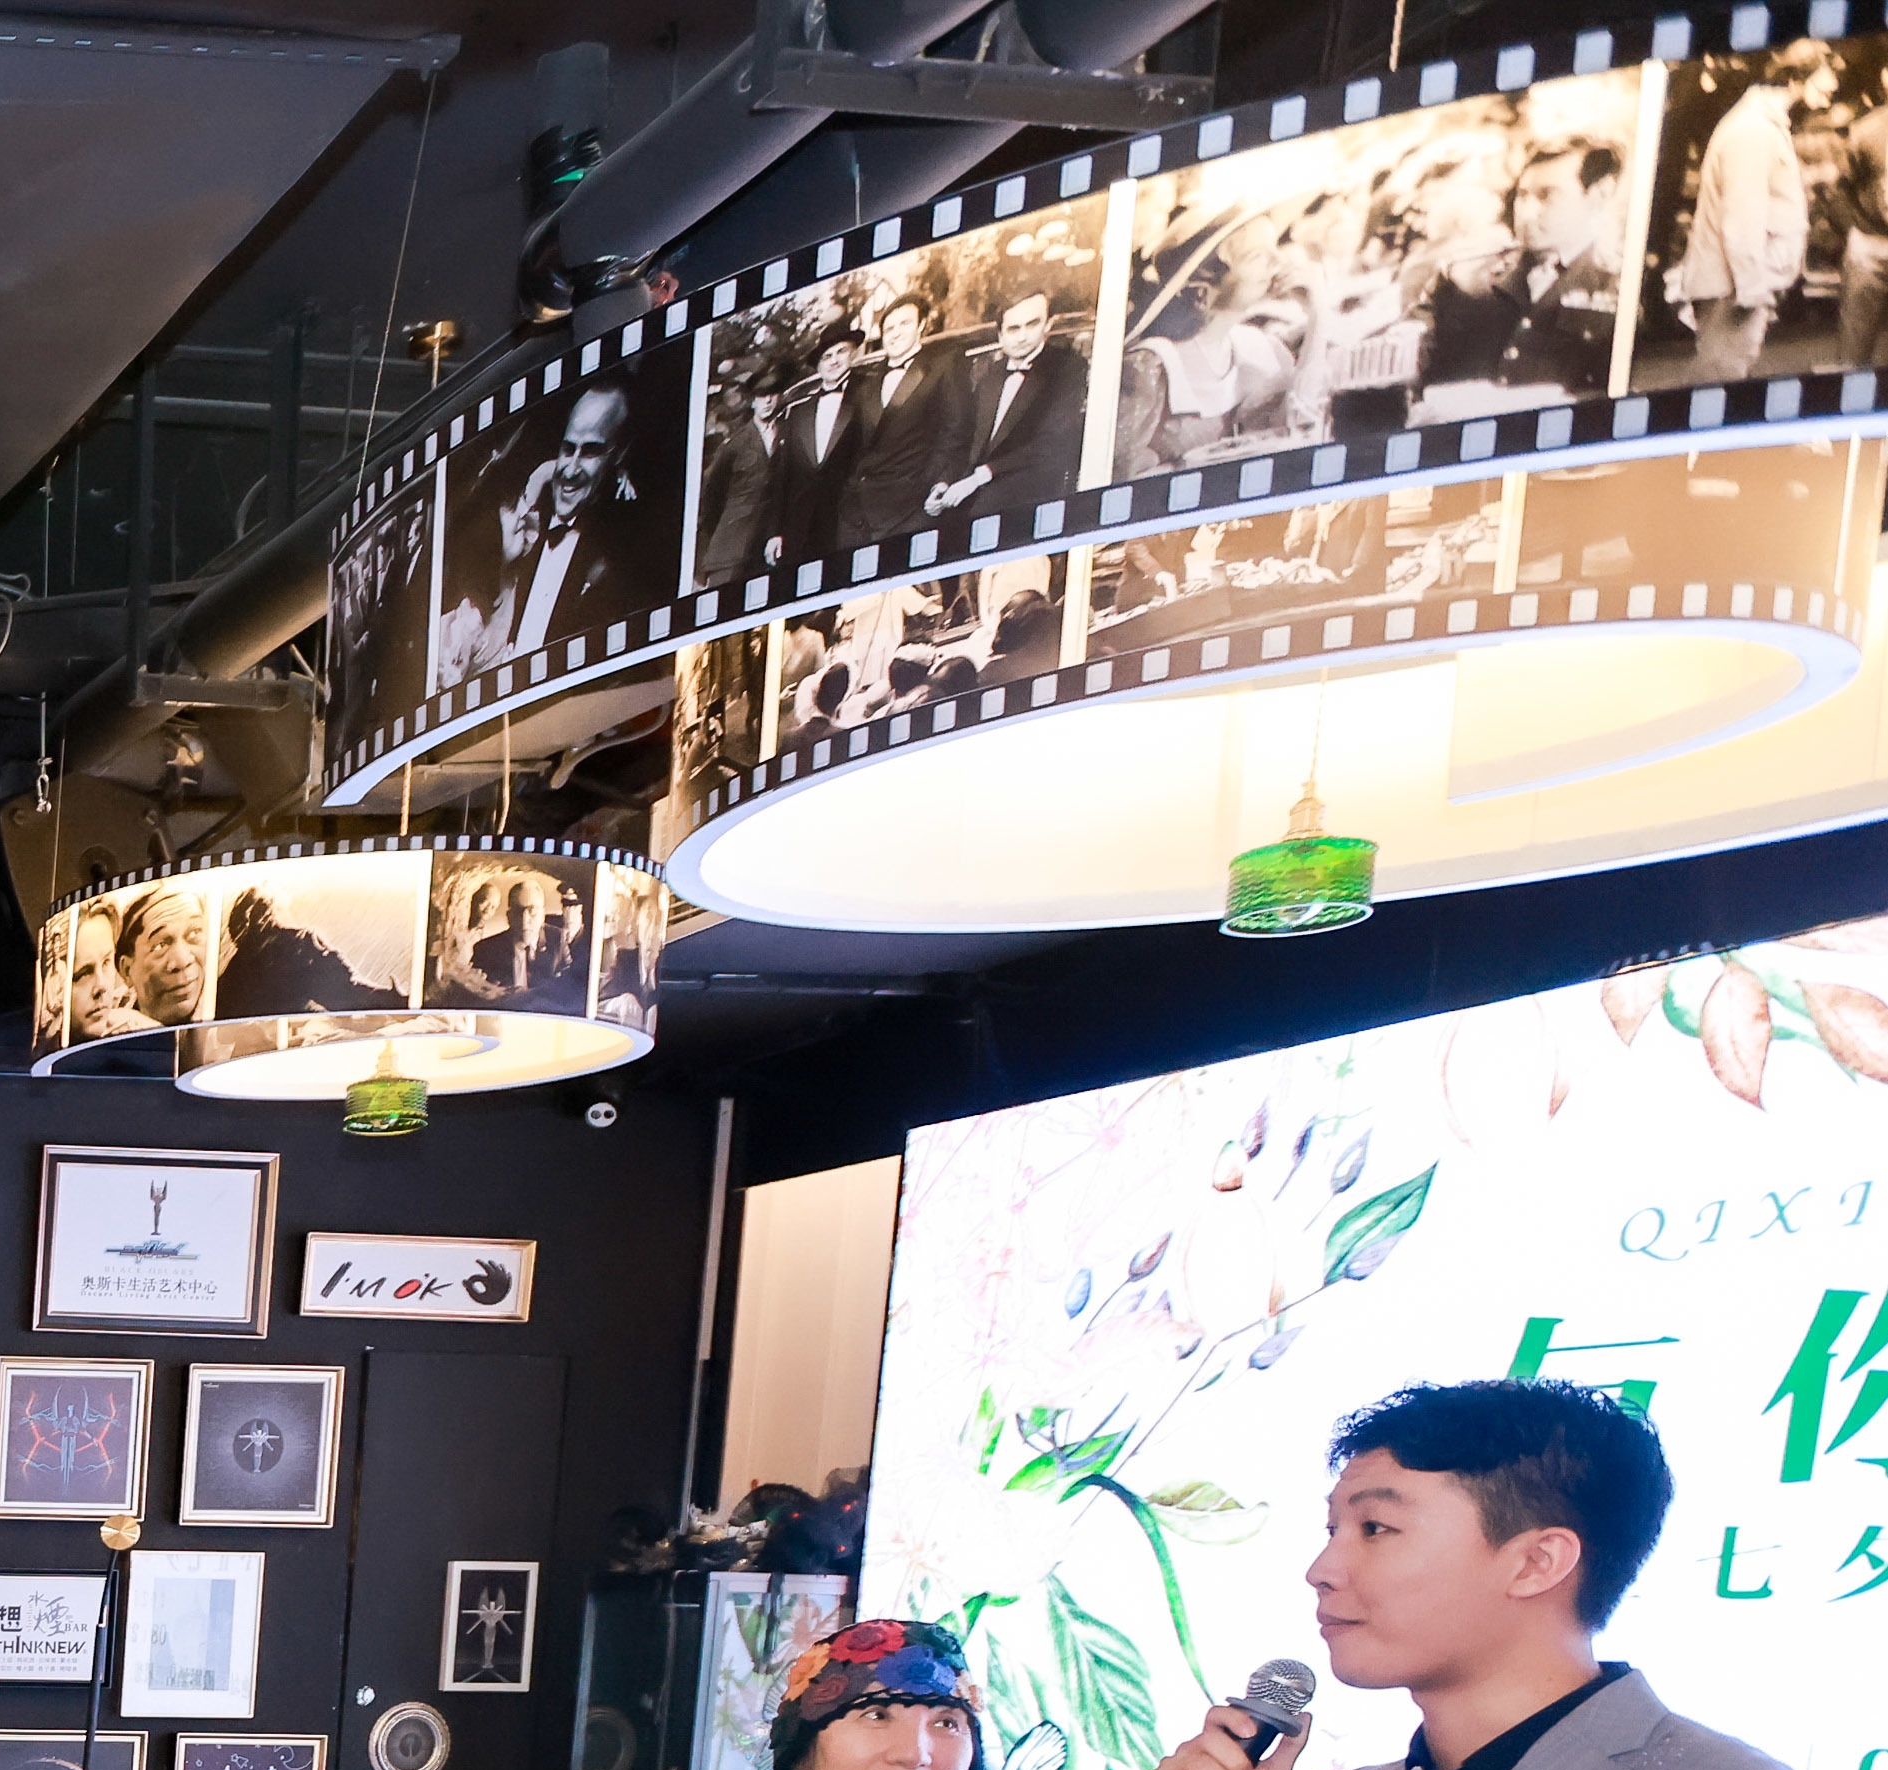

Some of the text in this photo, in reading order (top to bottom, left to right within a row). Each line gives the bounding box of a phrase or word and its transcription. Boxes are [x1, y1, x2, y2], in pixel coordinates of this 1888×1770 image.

[81, 1276, 218, 1294] 奥斯卡生活艺术中心
[64, 1623, 89, 1633] BAR
